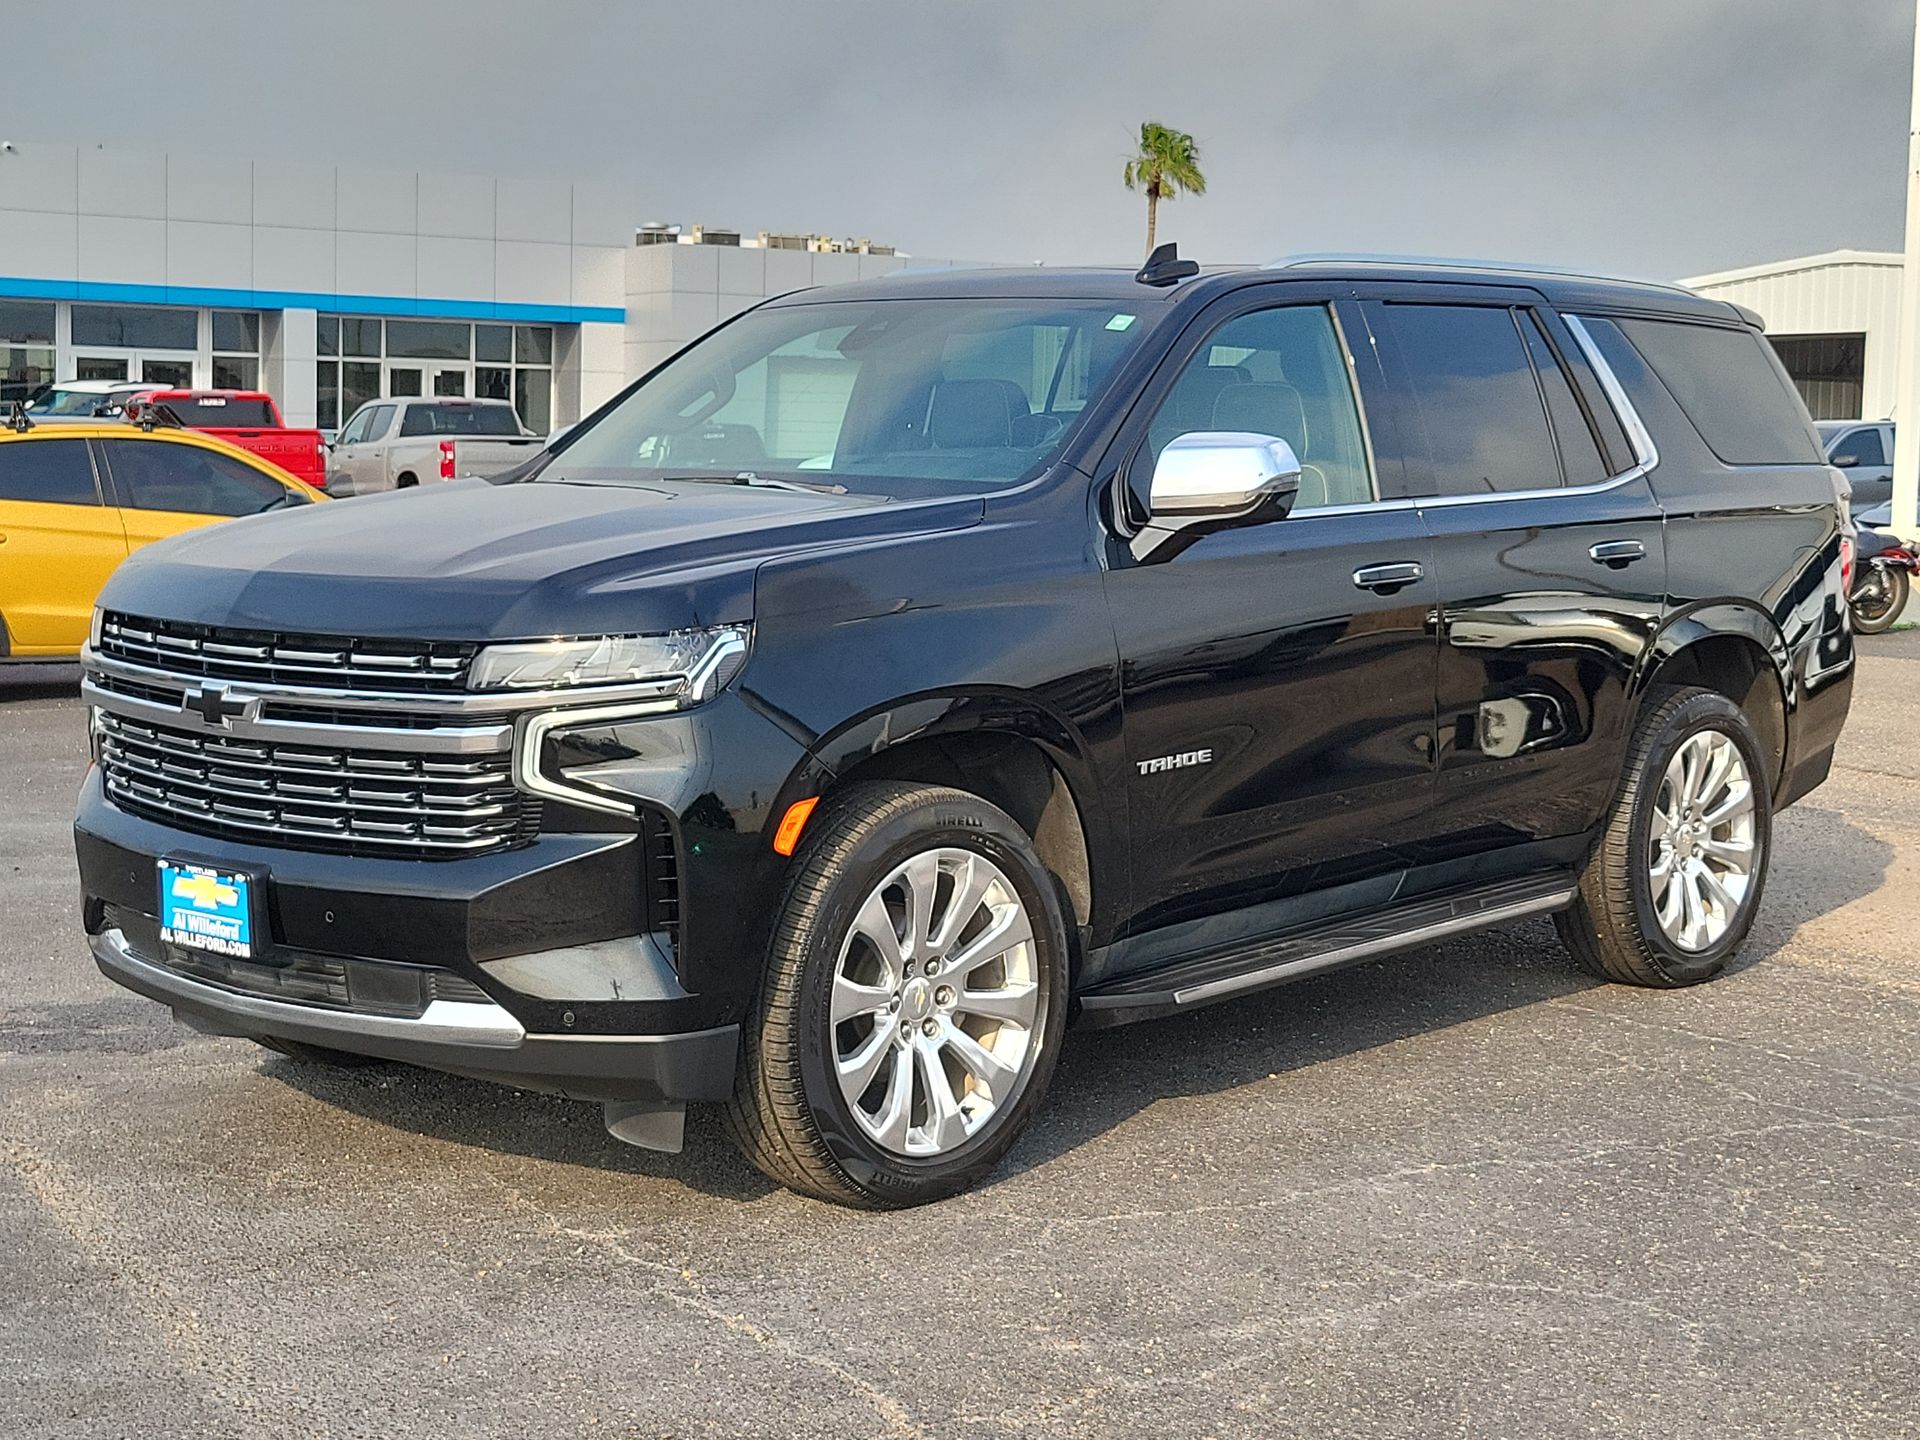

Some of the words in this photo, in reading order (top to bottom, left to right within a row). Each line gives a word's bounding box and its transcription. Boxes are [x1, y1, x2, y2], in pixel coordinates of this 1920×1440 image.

[1136, 748, 1213, 775] TAHOE
[172, 912, 186, 931] Al
[187, 914, 240, 941] Willeford
[174, 928, 251, 959] WILLEFORD.COM
